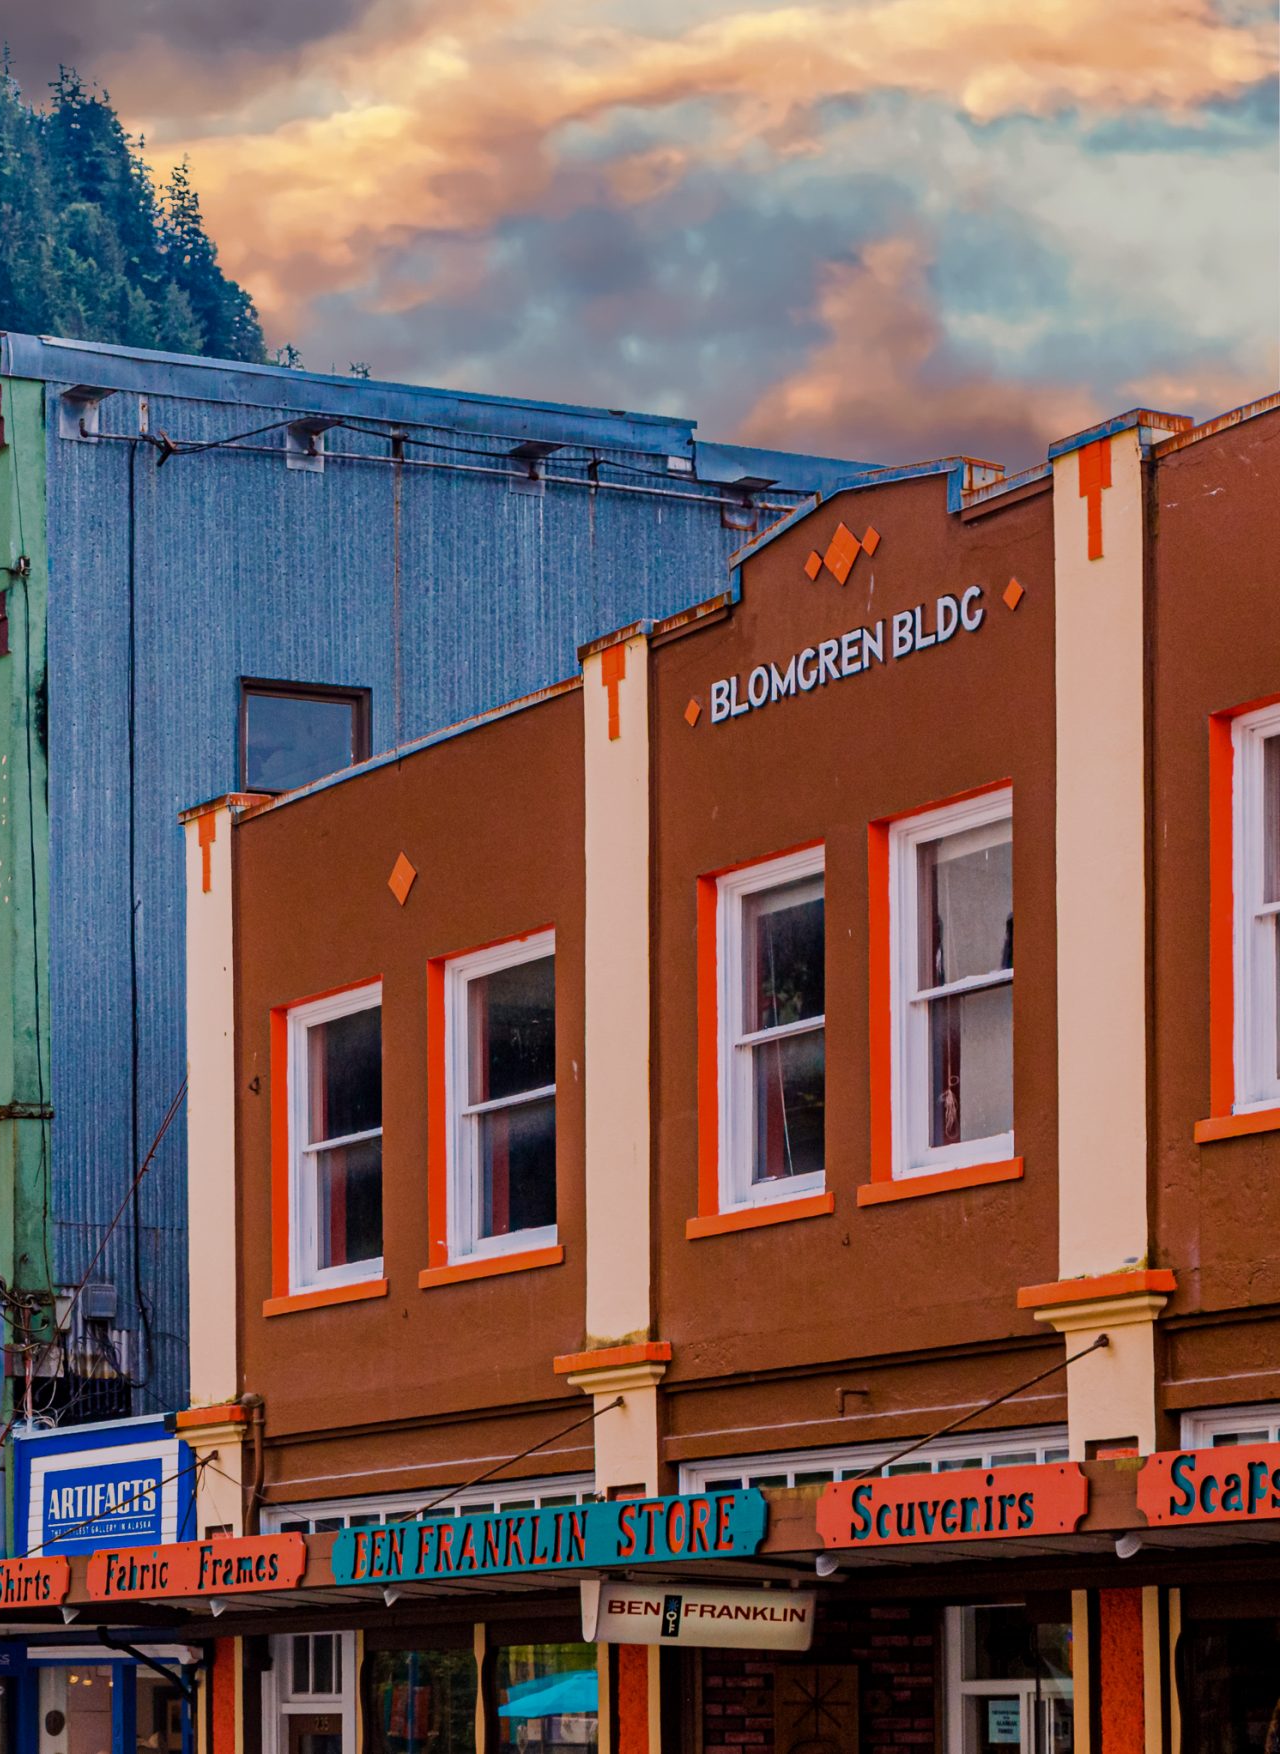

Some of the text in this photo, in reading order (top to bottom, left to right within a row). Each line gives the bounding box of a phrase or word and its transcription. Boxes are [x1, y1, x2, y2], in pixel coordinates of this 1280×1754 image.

[47, 1477, 157, 1520] ARTIFACTS
[850, 1473, 1034, 1540] Souvenirs
[127, 1520, 152, 1530] ALASKA
[351, 1495, 735, 1580] BEN FRANKLIN STORE
[105, 1545, 279, 1596] Fabric Frames
[607, 1599, 807, 1623] BEN FRANKLIN
